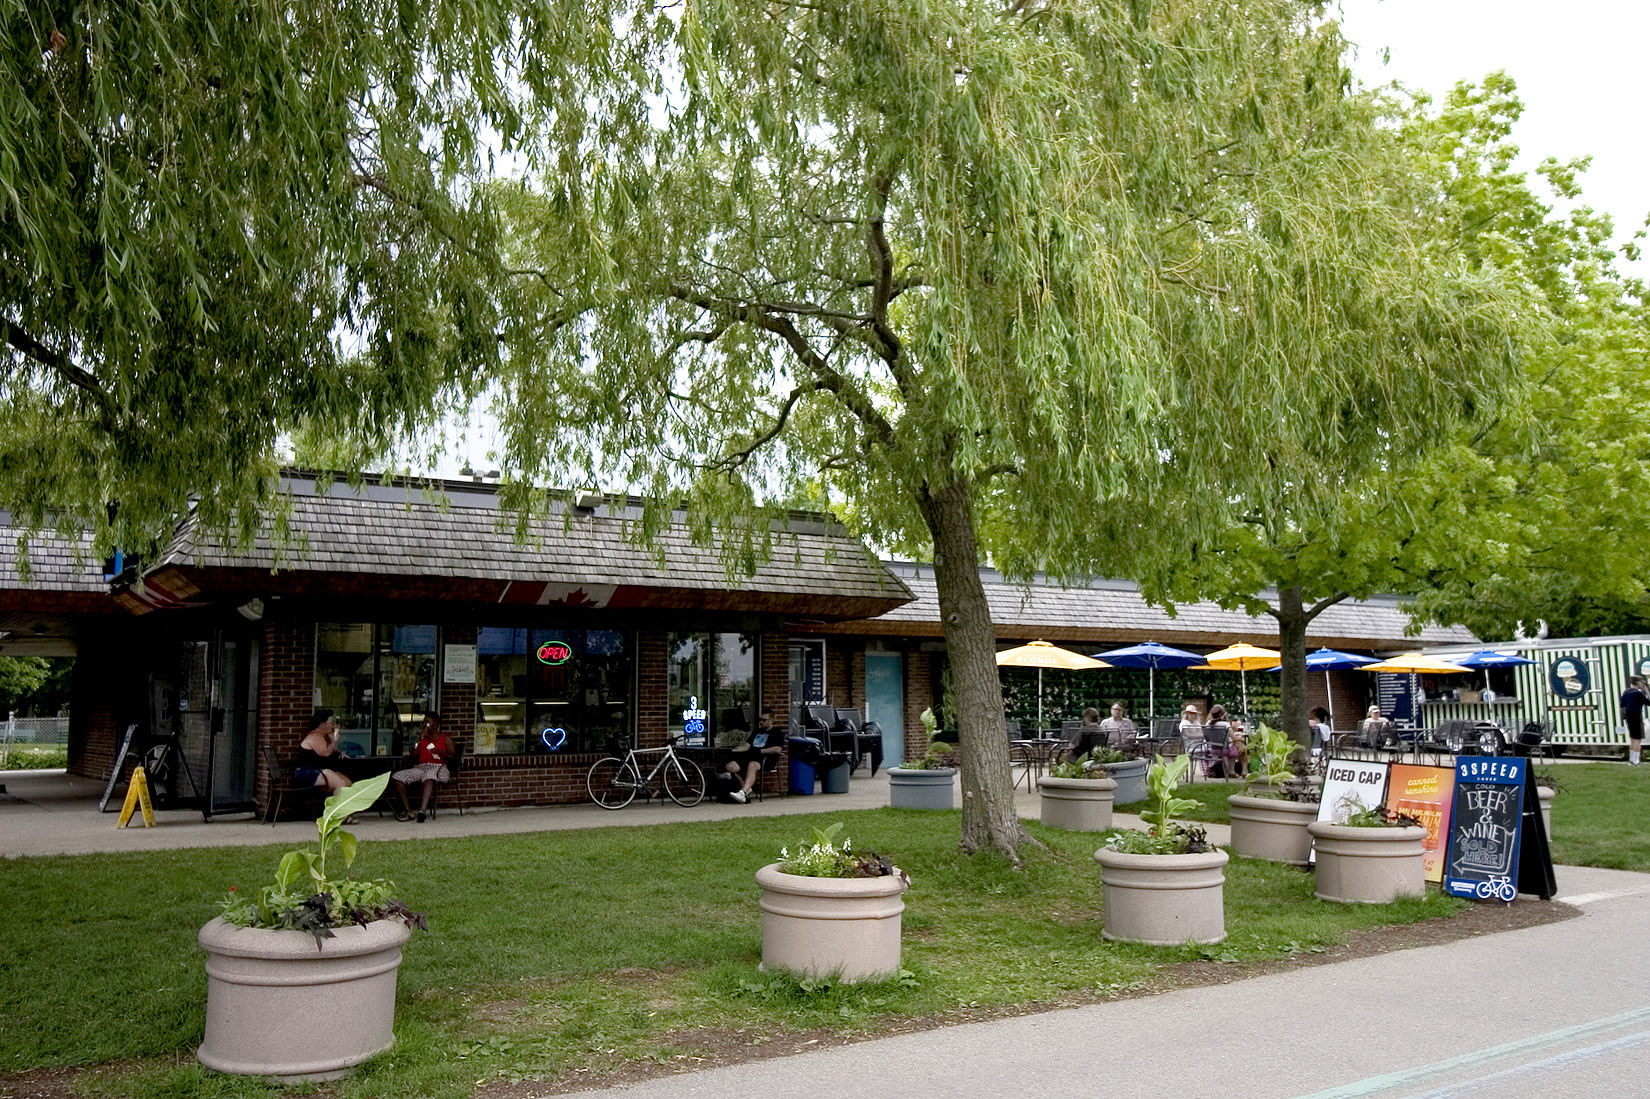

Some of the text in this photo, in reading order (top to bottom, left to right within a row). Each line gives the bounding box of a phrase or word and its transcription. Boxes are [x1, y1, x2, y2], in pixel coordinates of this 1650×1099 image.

[539, 647, 569, 660] OPEN
[1016, 656, 1057, 664] BLONDE
[690, 696, 697, 709] 3
[1329, 768, 1382, 785] ICED CAP
[1407, 774, 1438, 786] canned
[1404, 784, 1439, 795] sunshine
[1466, 790, 1507, 813] BEER
[1479, 807, 1493, 824] &
[1460, 823, 1502, 844] WINE
[1460, 838, 1498, 853] SOLD
[1463, 851, 1503, 867] HERE!
